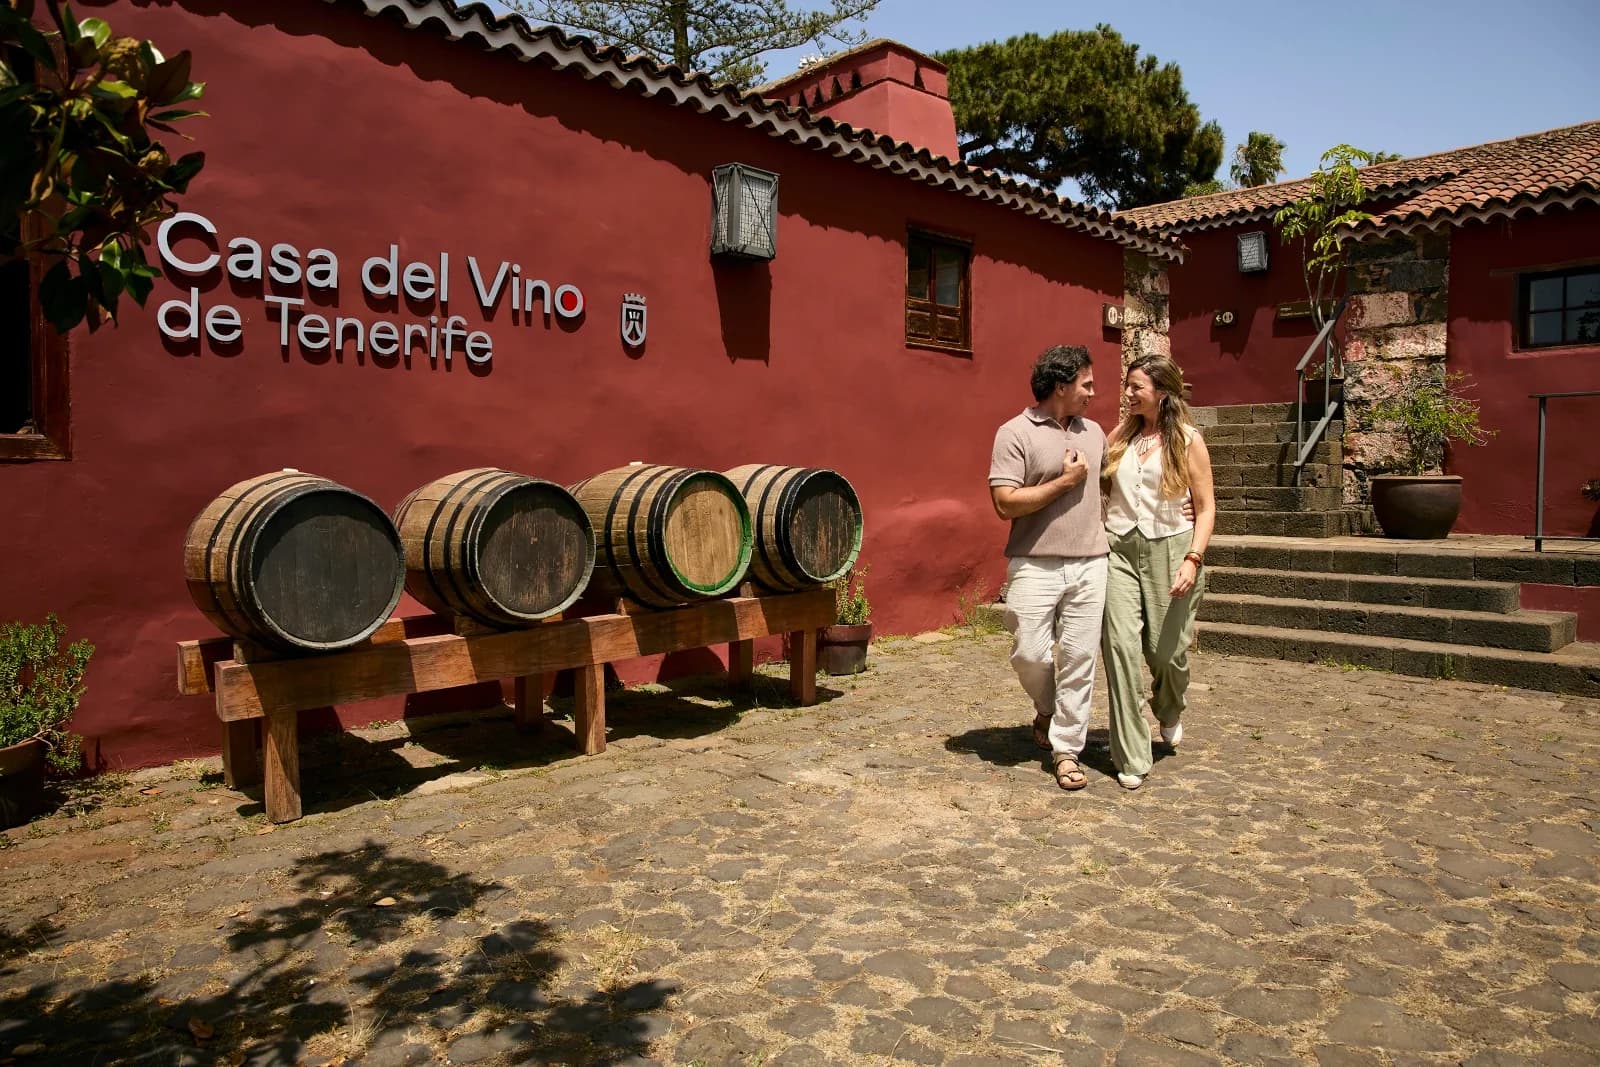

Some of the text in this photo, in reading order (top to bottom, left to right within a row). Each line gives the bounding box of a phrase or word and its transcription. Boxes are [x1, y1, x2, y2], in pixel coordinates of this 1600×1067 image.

[157, 211, 584, 318] Casa del Vino
[157, 287, 493, 363] de Tenerife
